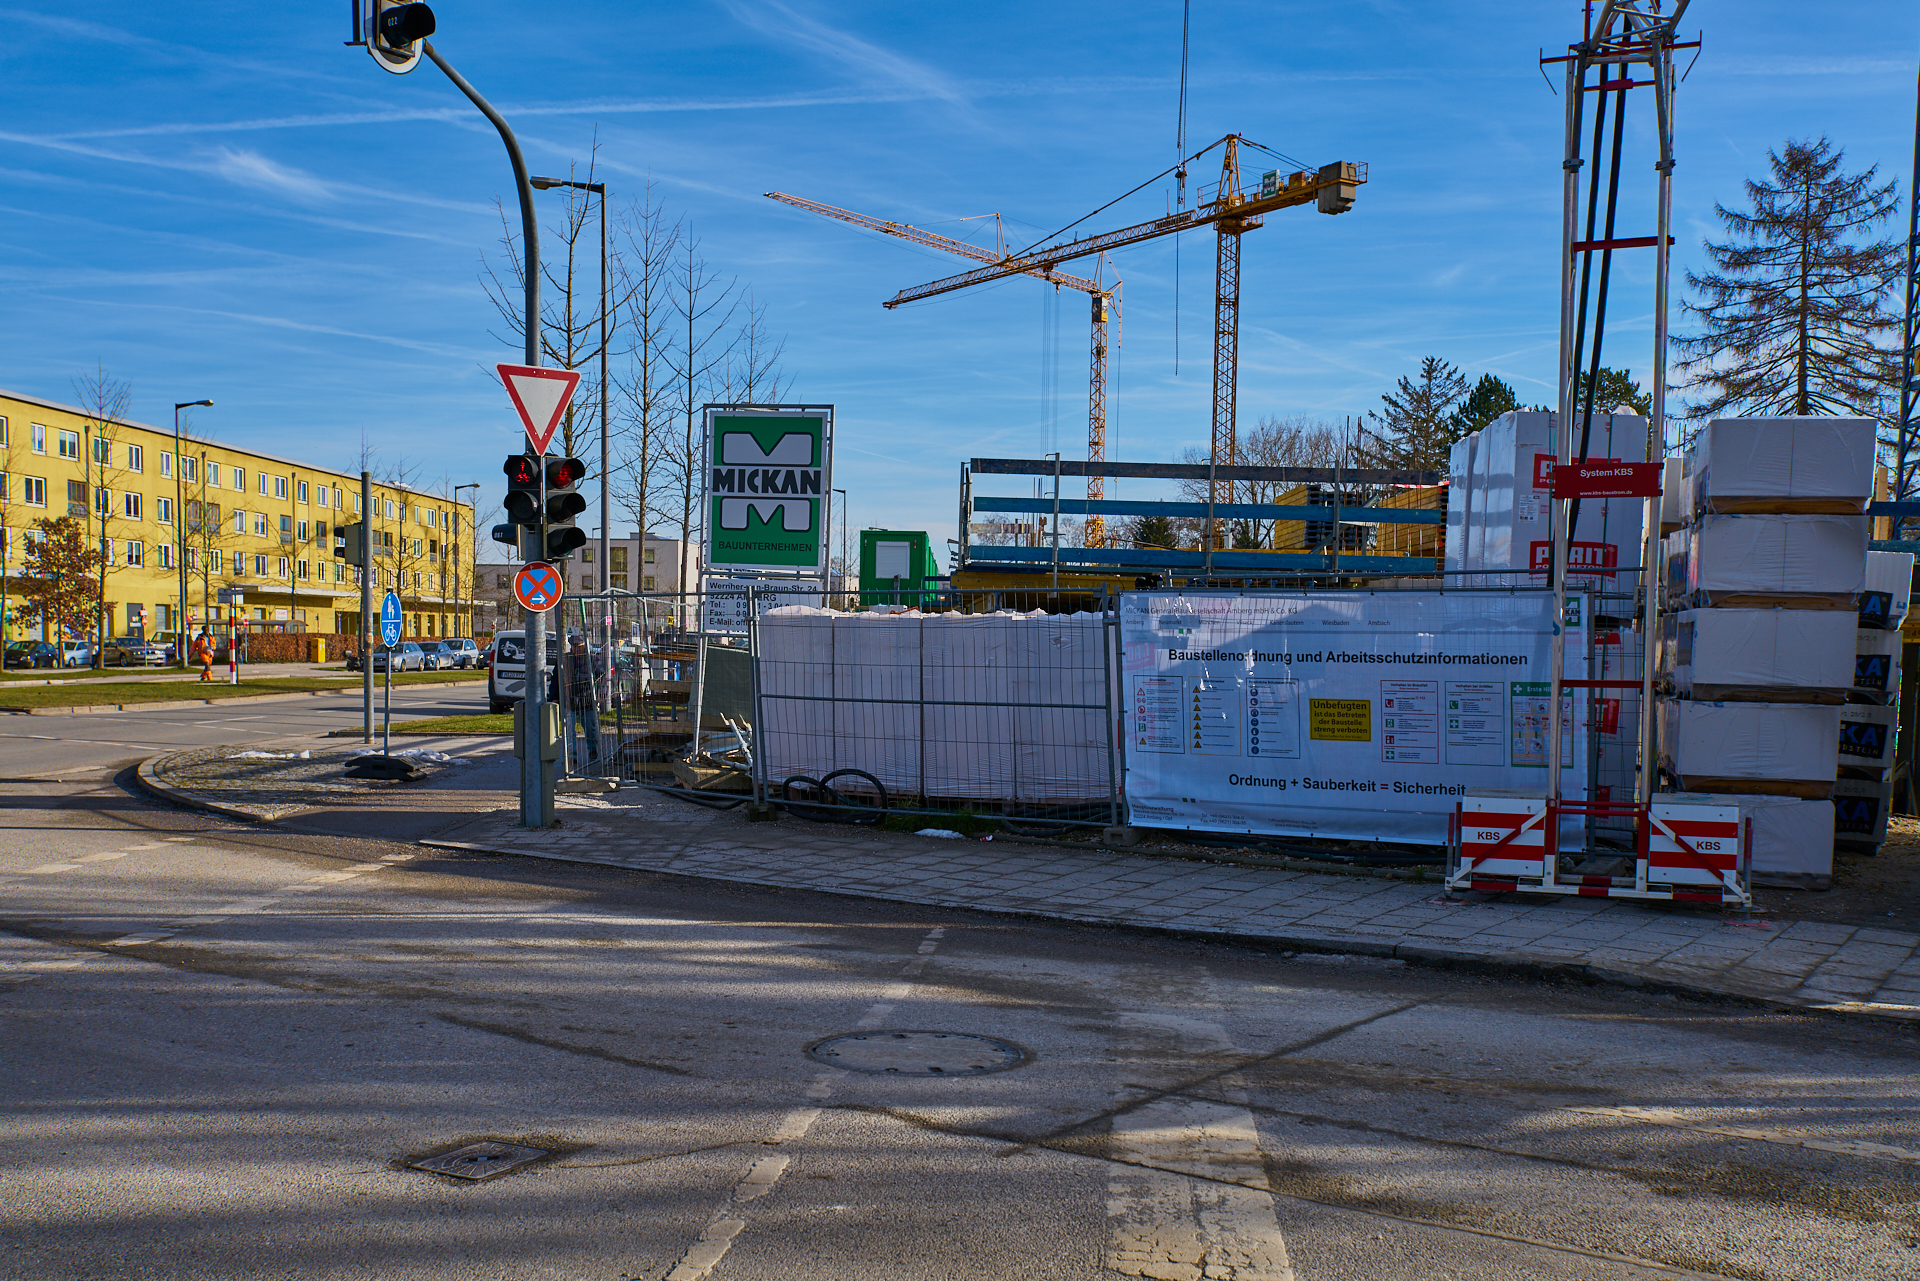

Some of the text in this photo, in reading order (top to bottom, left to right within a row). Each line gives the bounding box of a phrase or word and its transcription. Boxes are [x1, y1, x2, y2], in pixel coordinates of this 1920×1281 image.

[1580, 468, 1633, 478] System KBS
[712, 468, 821, 495] MICKAN
[718, 541, 812, 552] BAUUNTERNEHMEN
[1536, 547, 1606, 564] PRIT
[710, 601, 726, 609] Tel.:
[709, 610, 726, 619] Fax:
[1288, 607, 1298, 615] KG
[709, 618, 735, 629] E-Mail:
[1297, 651, 1322, 663] und
[1325, 651, 1528, 665] Arbeitsschutzinformationen
[1313, 701, 1367, 711] Unbefugten
[1314, 710, 1323, 718] ist
[1337, 711, 1367, 719] Betreten
[1331, 718, 1362, 726] Baustelle
[1313, 726, 1368, 734] streng verboten
[1228, 774, 1287, 790] Ordnung
[1290, 778, 1299, 787] +
[1302, 777, 1377, 792] Sauberkeit
[1392, 780, 1467, 796] Sicherheit
[1477, 831, 1500, 841] KBS
[1696, 841, 1721, 851] KBS
